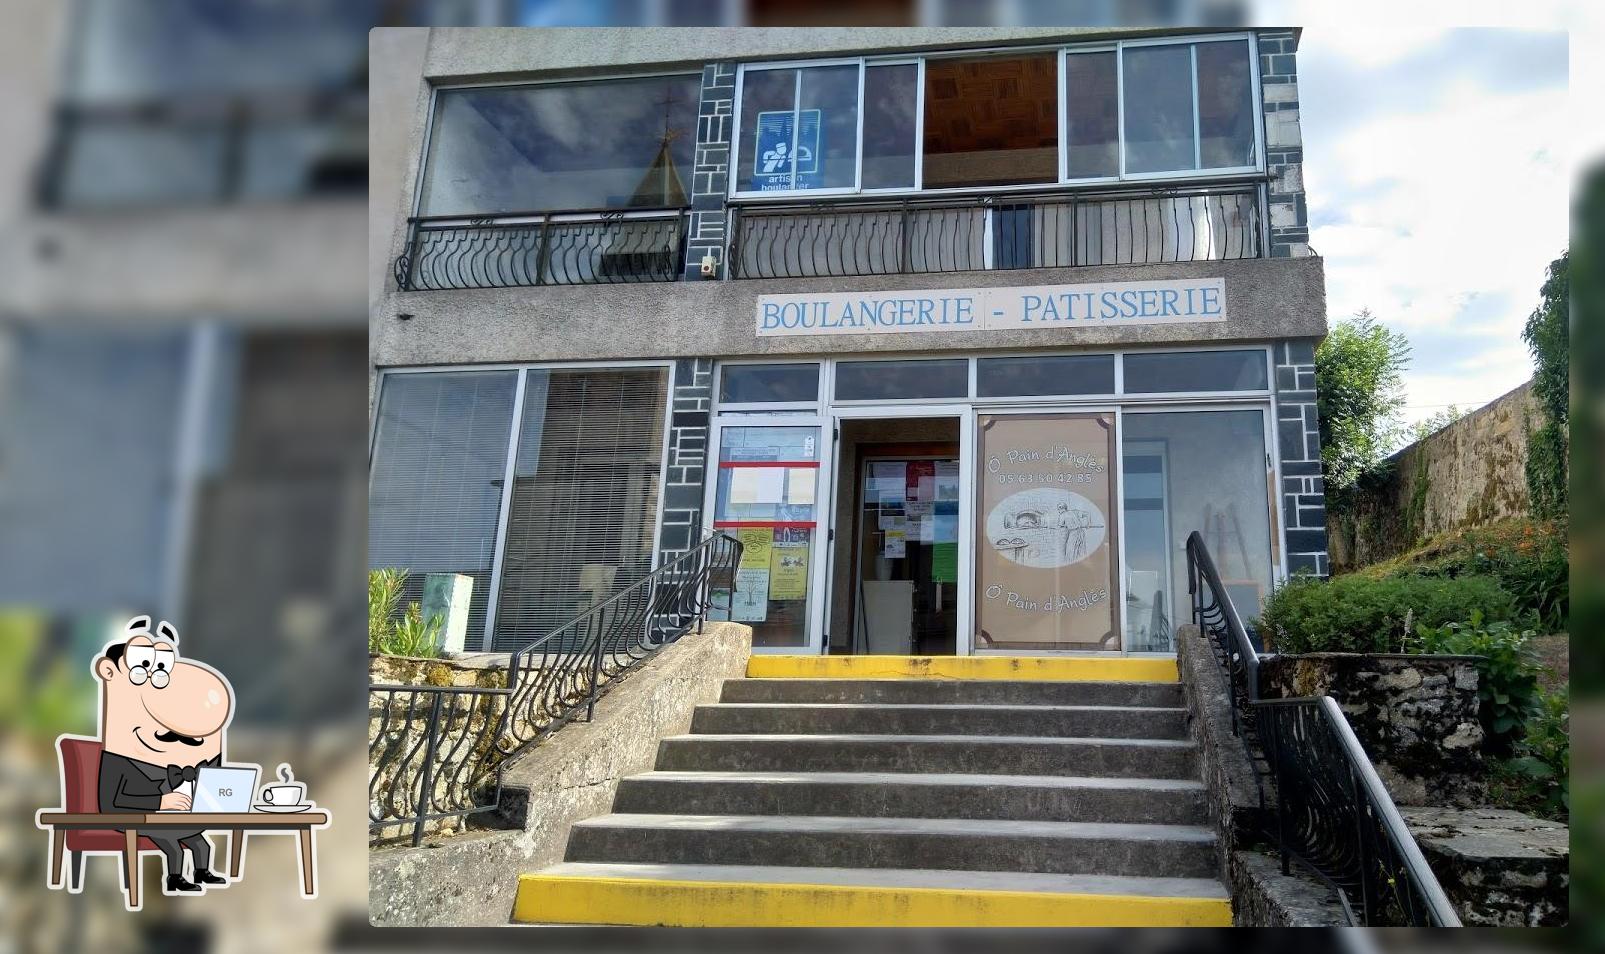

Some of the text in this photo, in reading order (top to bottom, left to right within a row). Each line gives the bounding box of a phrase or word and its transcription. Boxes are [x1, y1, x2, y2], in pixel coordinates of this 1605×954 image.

[768, 173, 803, 183] artisn
[761, 297, 974, 330] BOULANGERIE
[1021, 287, 1222, 322] PATISSERIE
[1007, 448, 1040, 465] Pain
[999, 474, 1014, 484] 05
[1018, 474, 1033, 484] 63
[1057, 473, 1073, 483] 42
[1006, 592, 1037, 611] Pain
